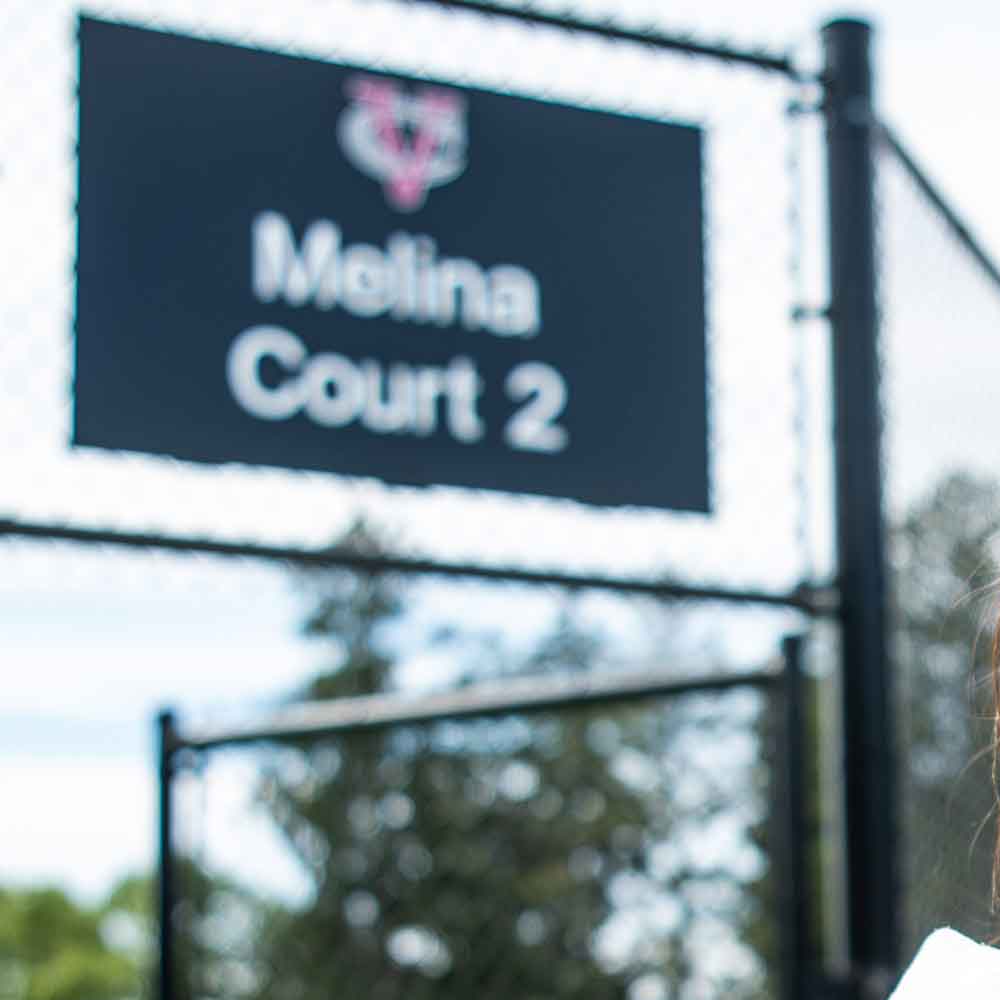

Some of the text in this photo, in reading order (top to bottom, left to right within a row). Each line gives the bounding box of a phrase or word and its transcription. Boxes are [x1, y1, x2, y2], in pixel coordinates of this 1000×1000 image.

[251, 211, 542, 338] Melina
[227, 325, 568, 453] Court 2
